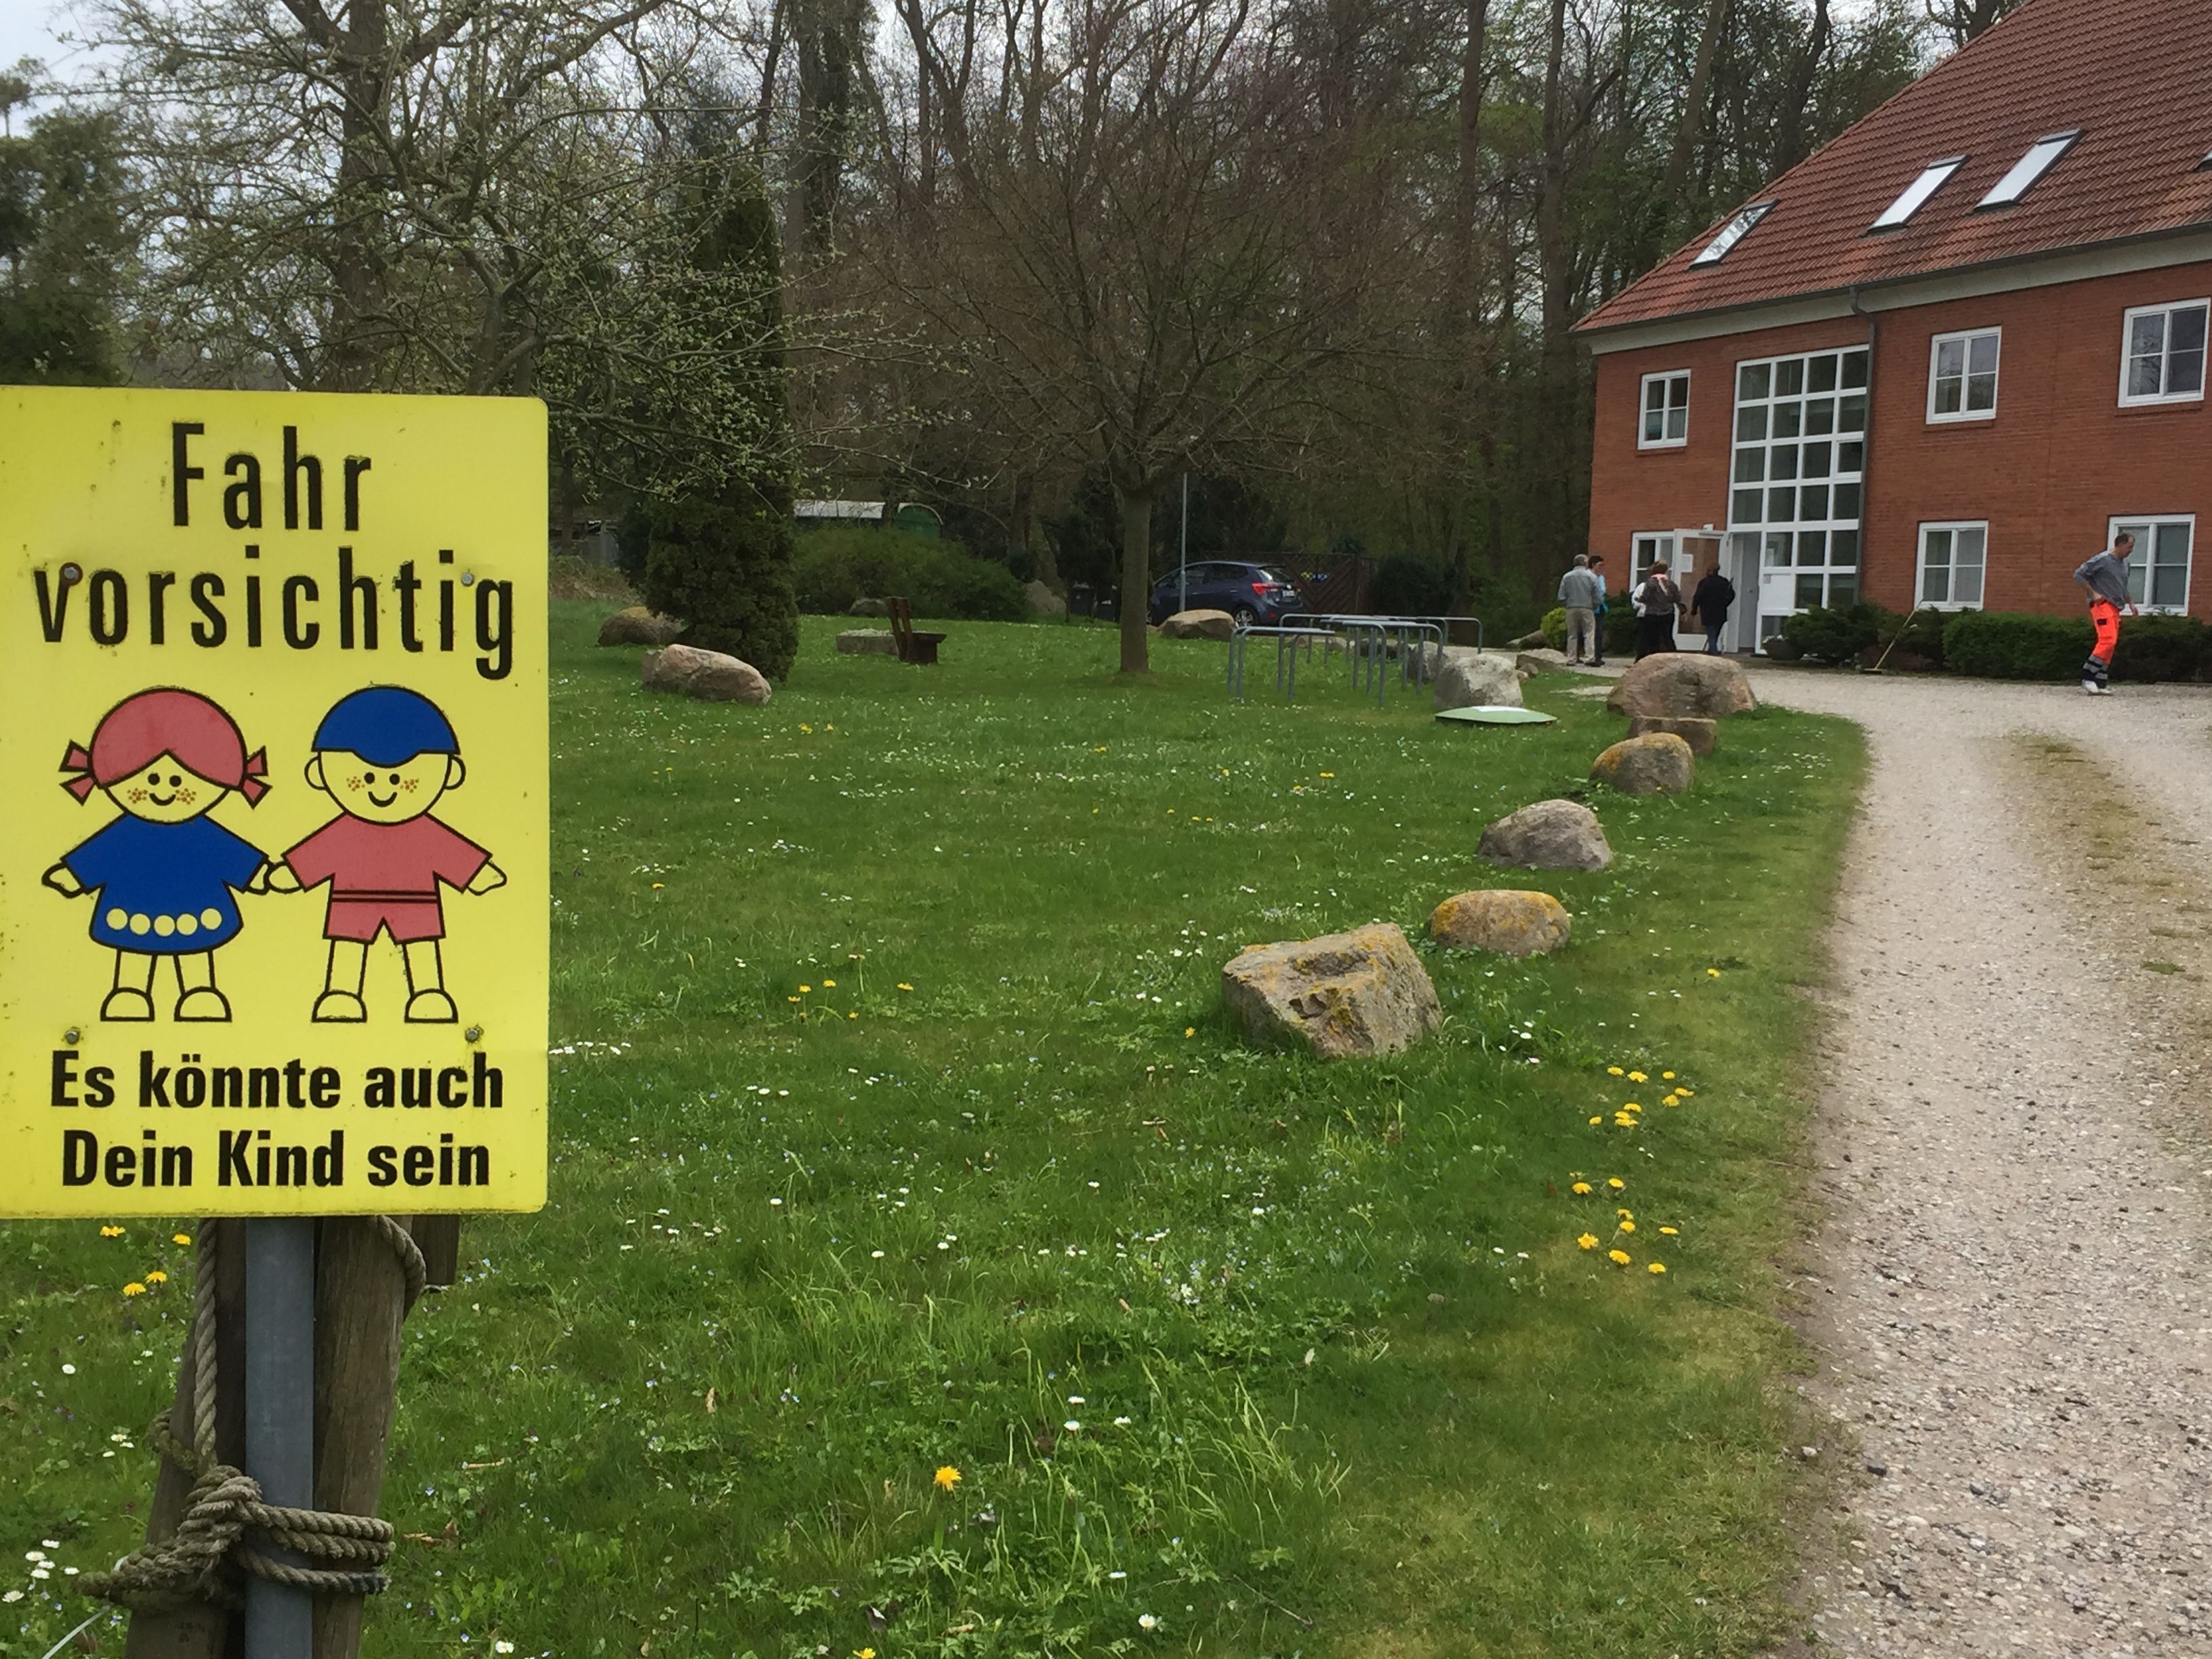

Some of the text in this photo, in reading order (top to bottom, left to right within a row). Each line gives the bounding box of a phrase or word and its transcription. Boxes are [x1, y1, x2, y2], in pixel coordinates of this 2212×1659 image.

[172, 422, 371, 531] Fahr
[33, 545, 512, 680] vorsichtig
[51, 1050, 503, 1109] Es könnte auch
[62, 1130, 489, 1187] Dein Kind sein
